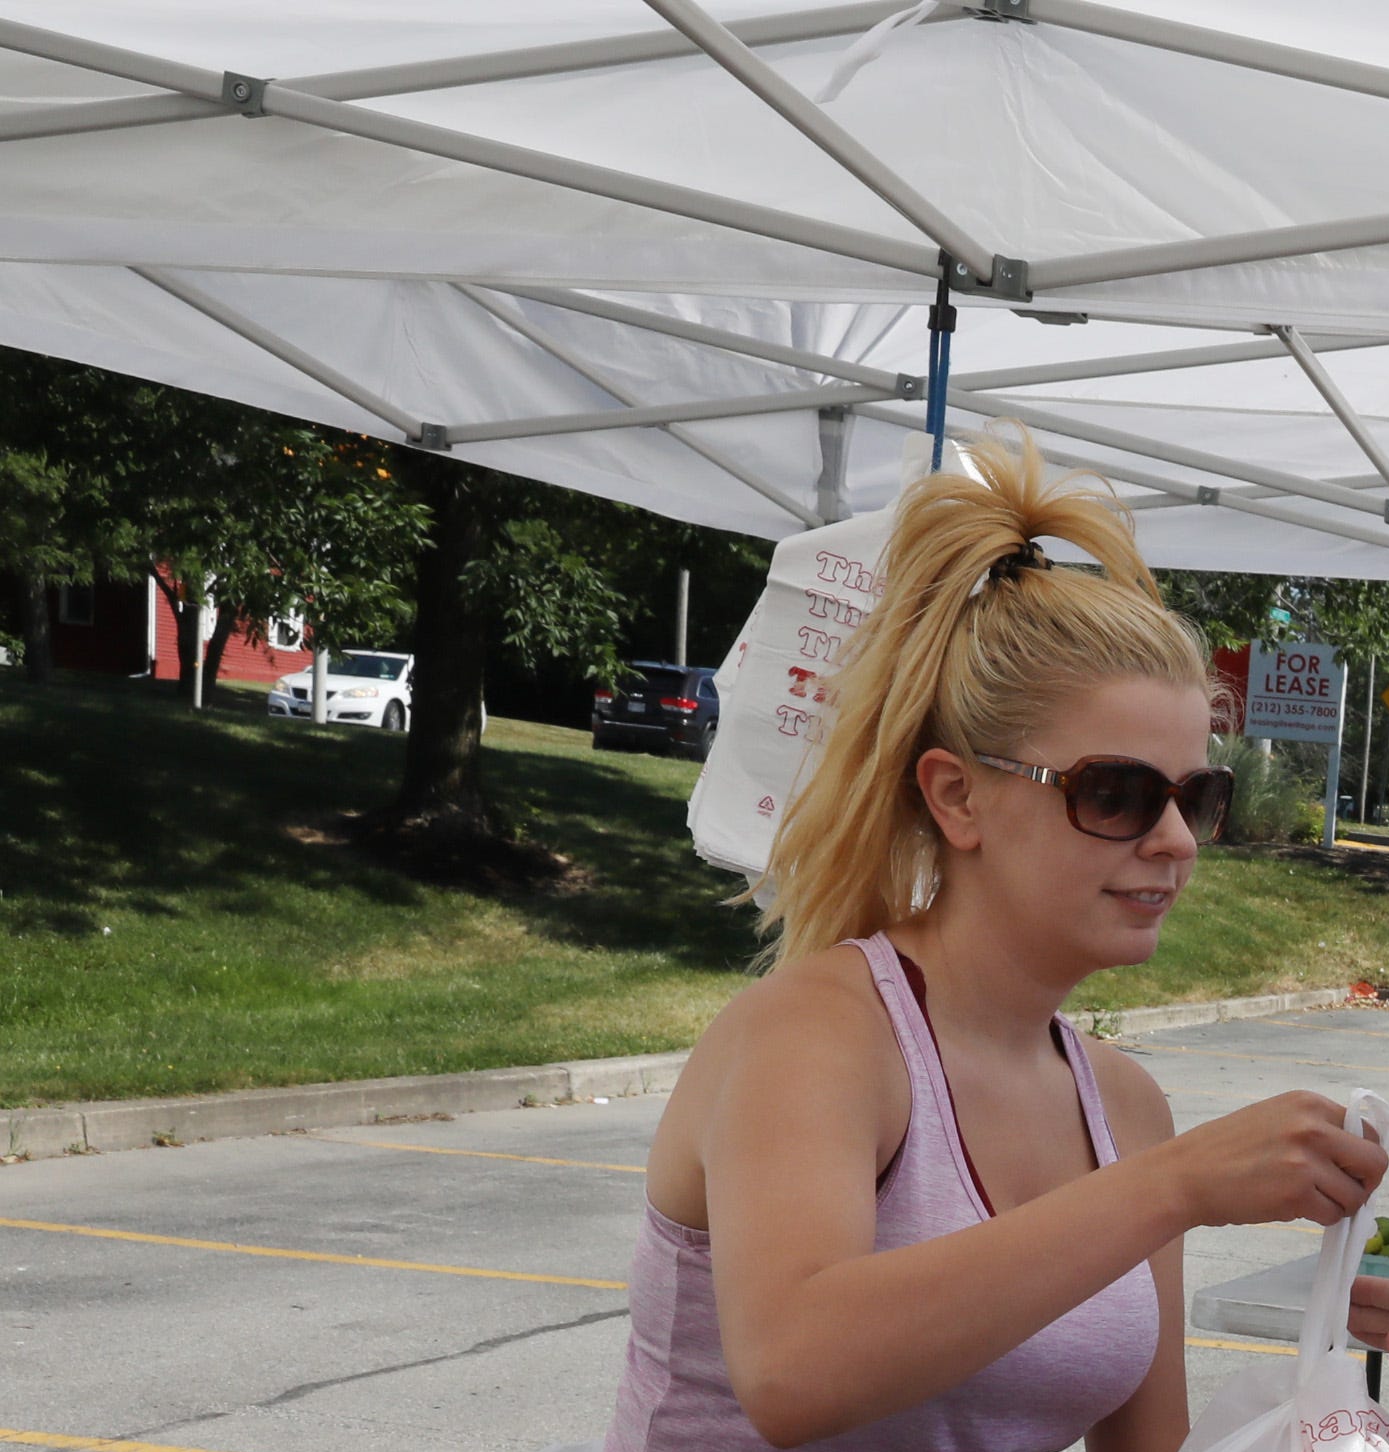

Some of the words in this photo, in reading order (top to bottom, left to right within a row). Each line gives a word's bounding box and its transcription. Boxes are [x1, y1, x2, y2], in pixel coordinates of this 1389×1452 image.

[1276, 652, 1321, 675] FOR
[1264, 673, 1331, 697] LEASE
[1251, 701, 1282, 716] (212)
[1284, 703, 1338, 718] 355-7800
